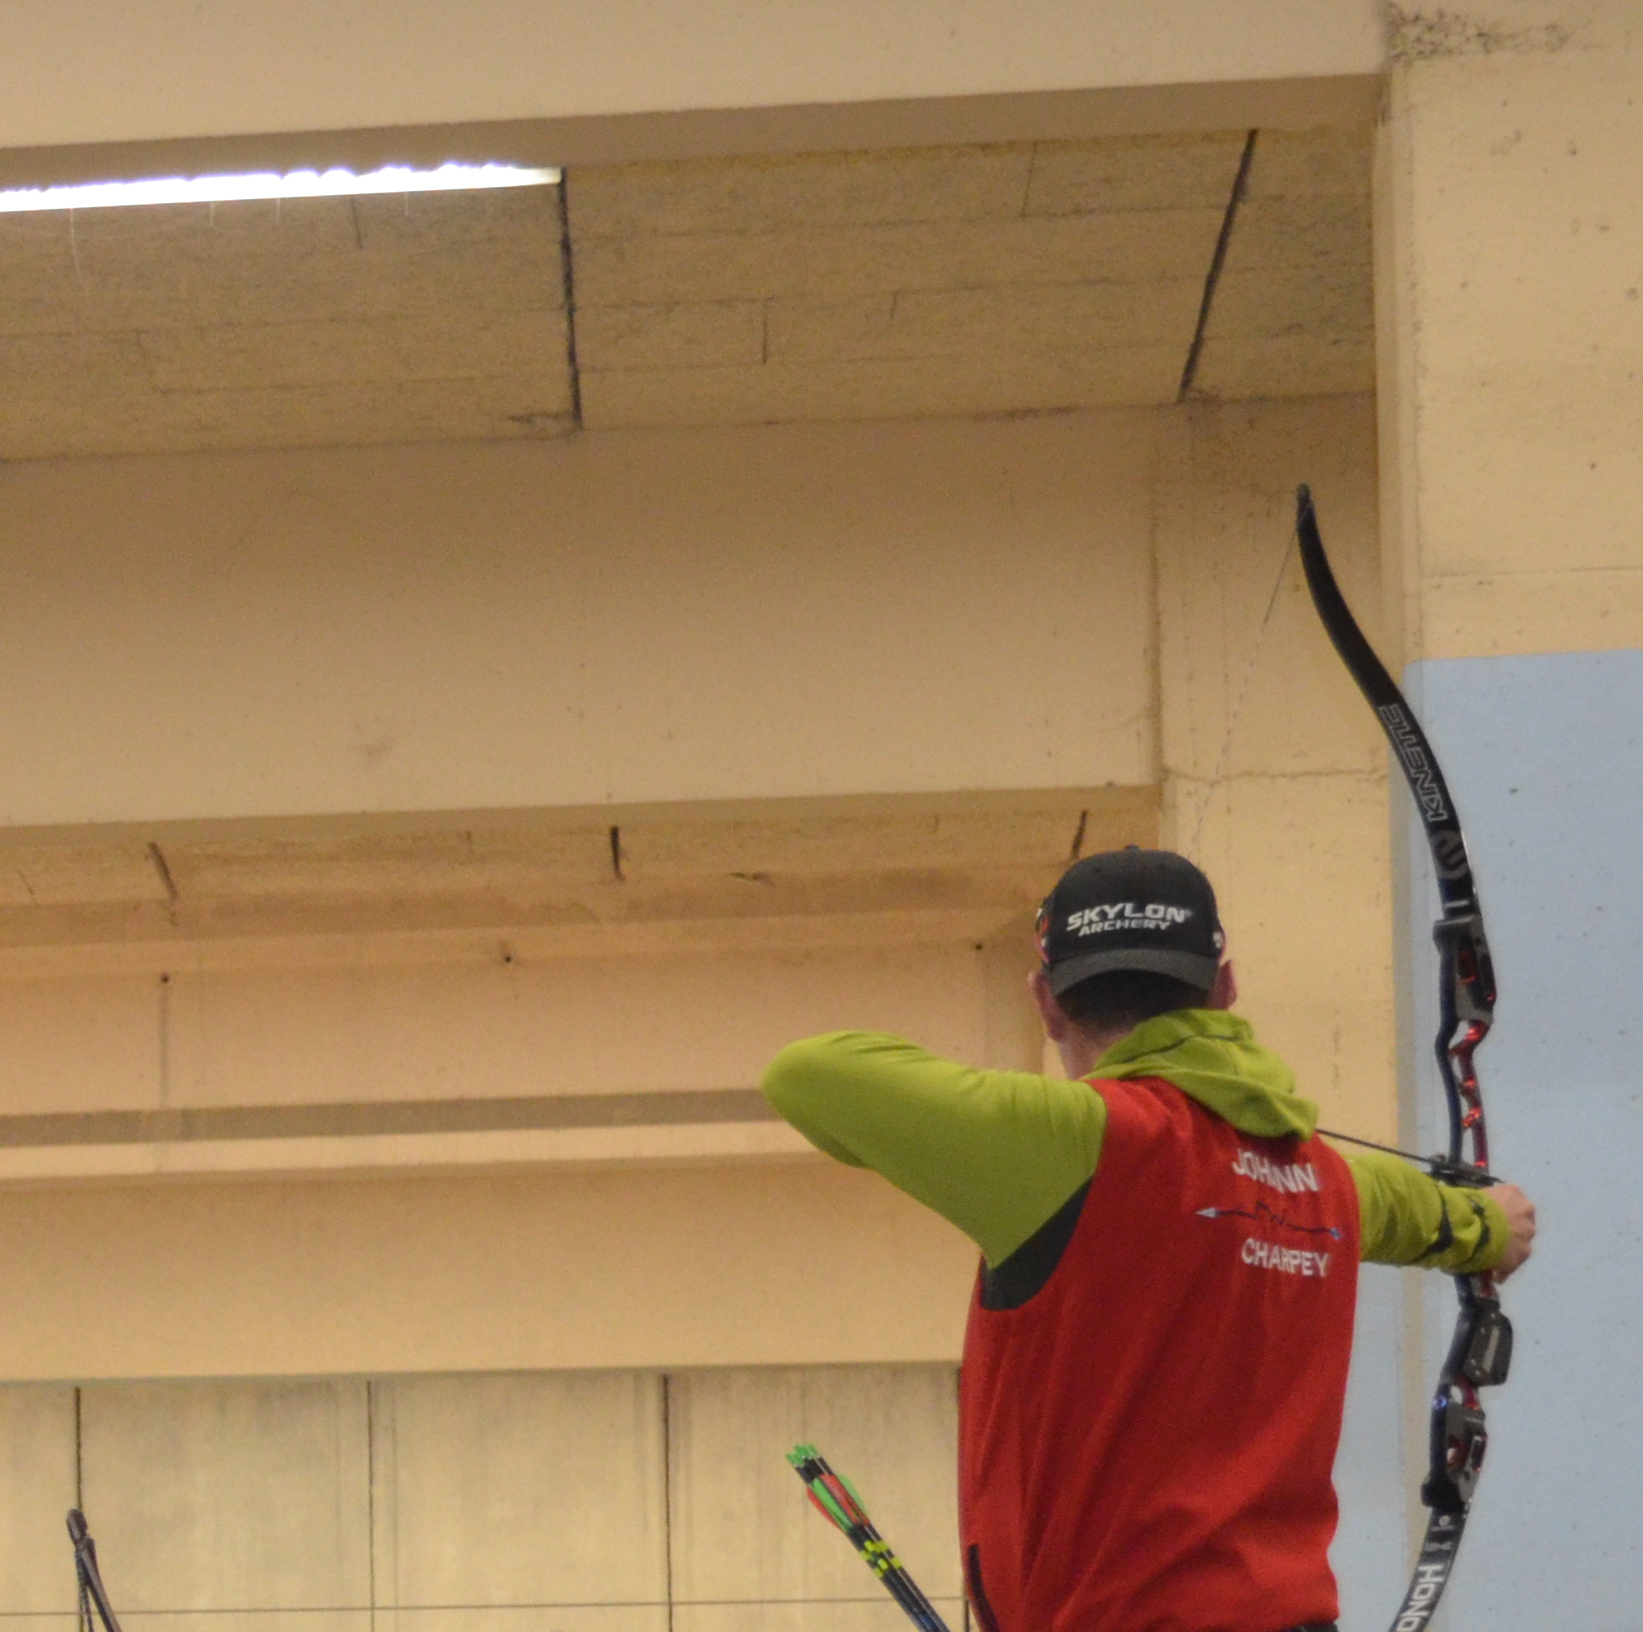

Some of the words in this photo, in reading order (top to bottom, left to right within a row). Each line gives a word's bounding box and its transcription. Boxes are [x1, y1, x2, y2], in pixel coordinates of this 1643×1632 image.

[1377, 703, 1448, 822] KINETIC
[1066, 902, 1186, 932] SKYLON
[1078, 919, 1171, 937] ARCHERY
[1241, 1237, 1330, 1278] CHARPEY
